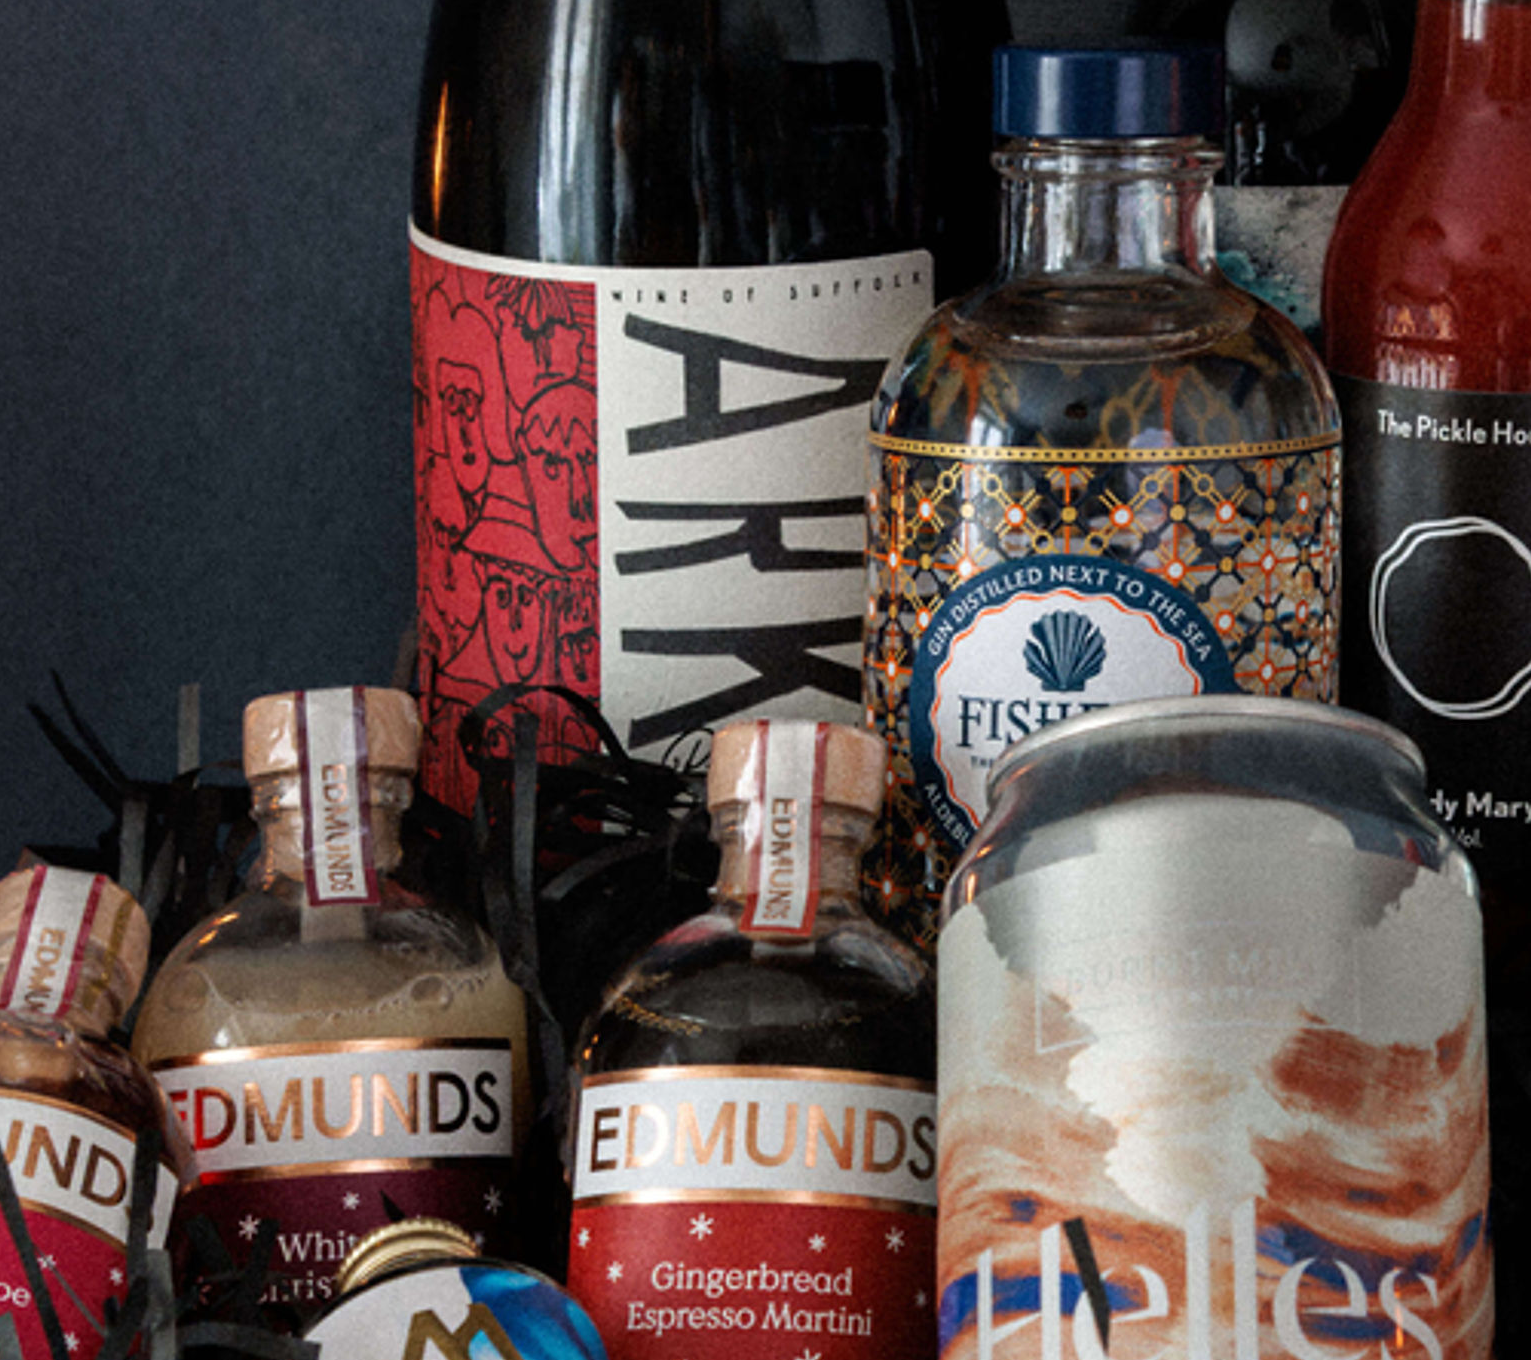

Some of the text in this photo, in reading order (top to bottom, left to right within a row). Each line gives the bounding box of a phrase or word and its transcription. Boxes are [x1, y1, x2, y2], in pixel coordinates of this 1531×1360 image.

[722, 286, 756, 303] OF
[789, 270, 923, 301] SUFFOLK
[1377, 408, 1412, 440] The
[1416, 415, 1487, 445] Pickle
[927, 563, 1213, 663] GIN DISTILLED NEXT TO THE SEA
[955, 694, 1113, 749] FISH
[321, 762, 355, 896] EDMUNDS
[761, 797, 799, 921] EDMUNDS
[588, 1101, 937, 1182] EDMUNDS
[277, 1231, 359, 1263] Whit
[650, 1261, 854, 1299] Gingerbread
[626, 1300, 872, 1337] Espresso Martini
